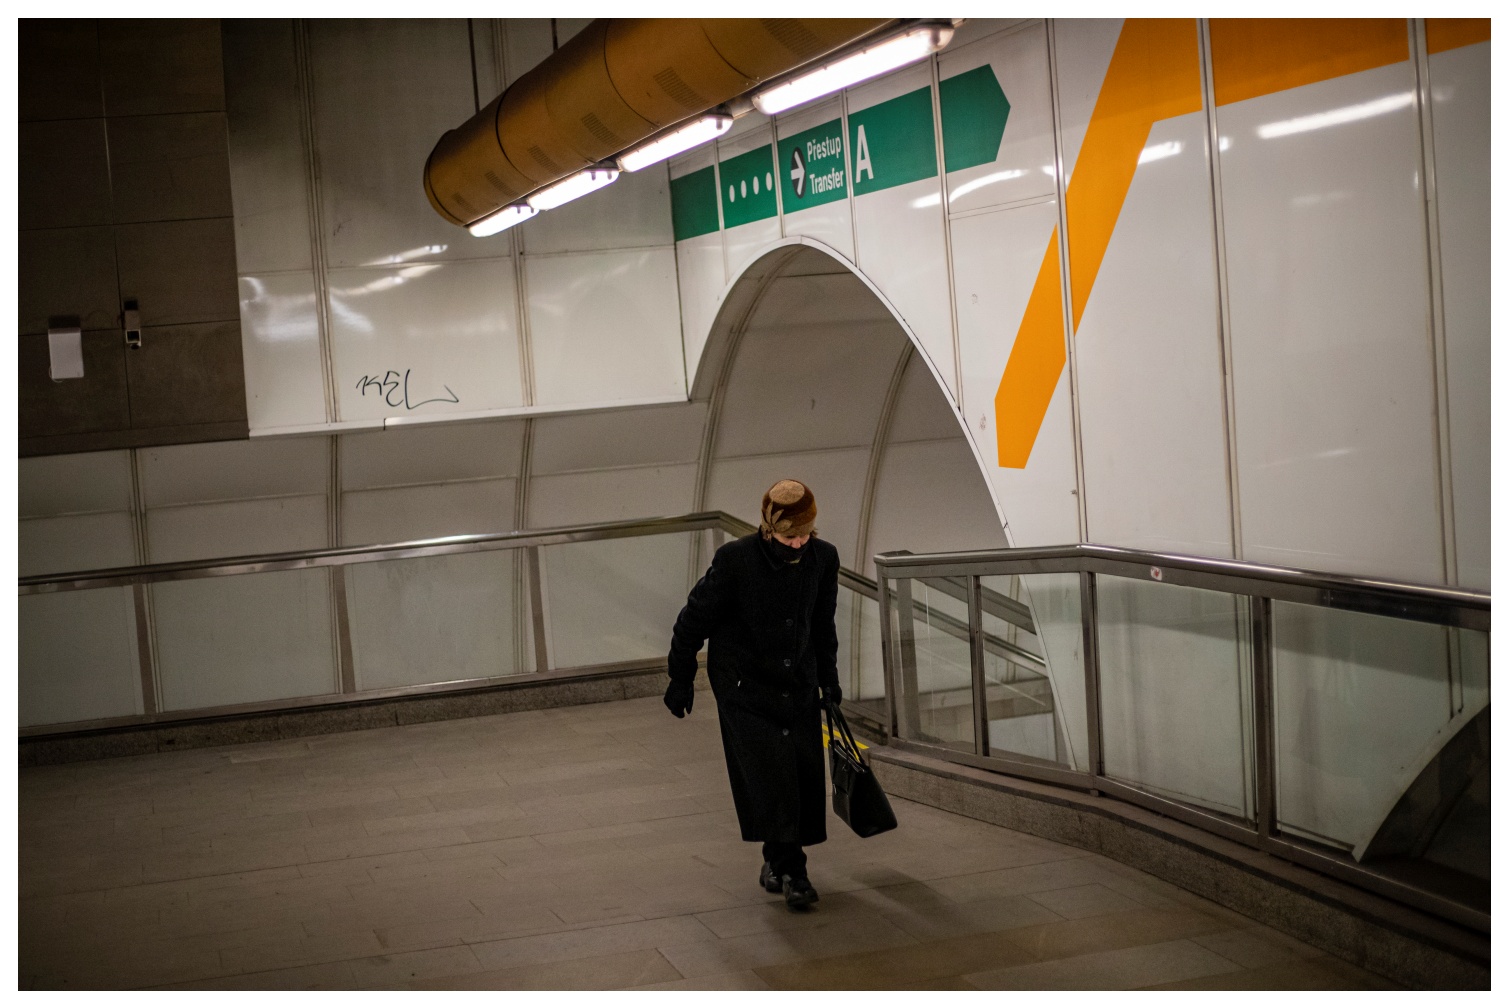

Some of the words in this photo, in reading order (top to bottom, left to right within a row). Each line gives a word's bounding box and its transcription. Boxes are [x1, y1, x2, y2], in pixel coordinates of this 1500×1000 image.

[806, 136, 841, 163] Přestup
[856, 124, 874, 184] A
[809, 167, 844, 195] Transfer
